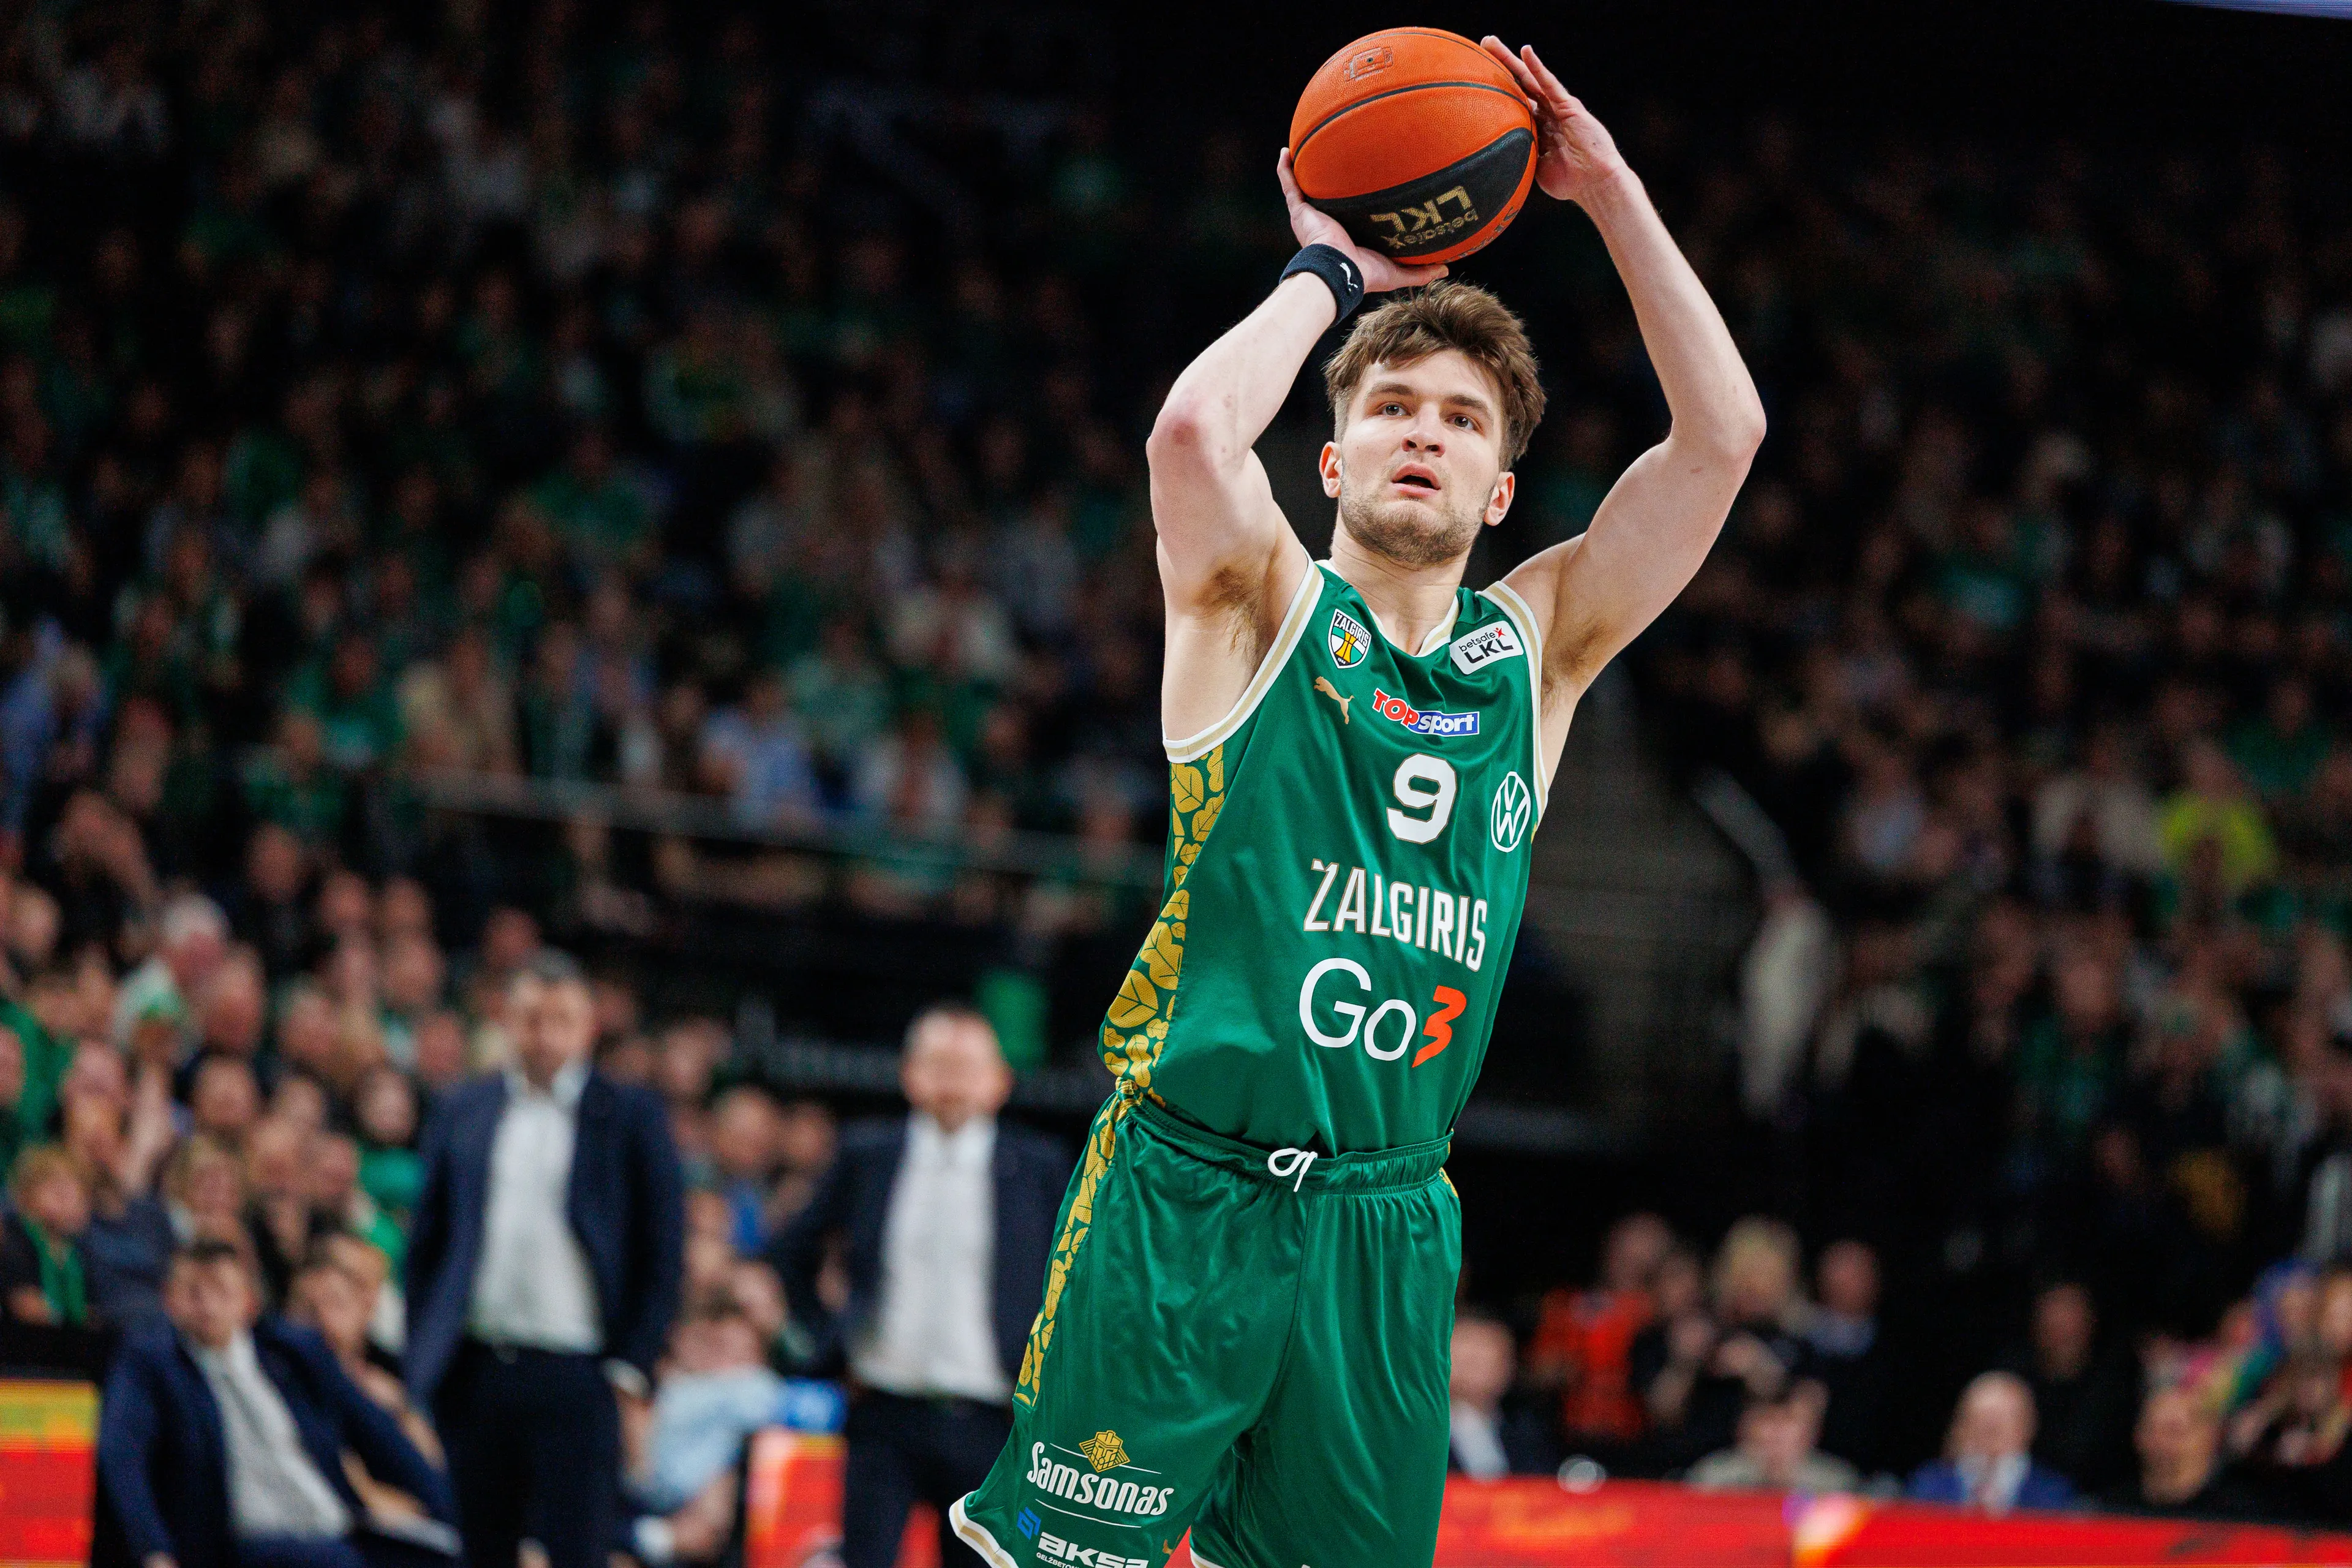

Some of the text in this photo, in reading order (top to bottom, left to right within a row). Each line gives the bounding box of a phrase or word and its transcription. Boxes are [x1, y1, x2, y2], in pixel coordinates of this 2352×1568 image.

[1370, 186, 1472, 233] LKL
[1459, 632, 1496, 652] betsafe
[1464, 638, 1513, 663] LKL
[1386, 752, 1458, 845] 9
[1299, 957, 1467, 1068] Go3
[1027, 1441, 1174, 1515] Samsonas
